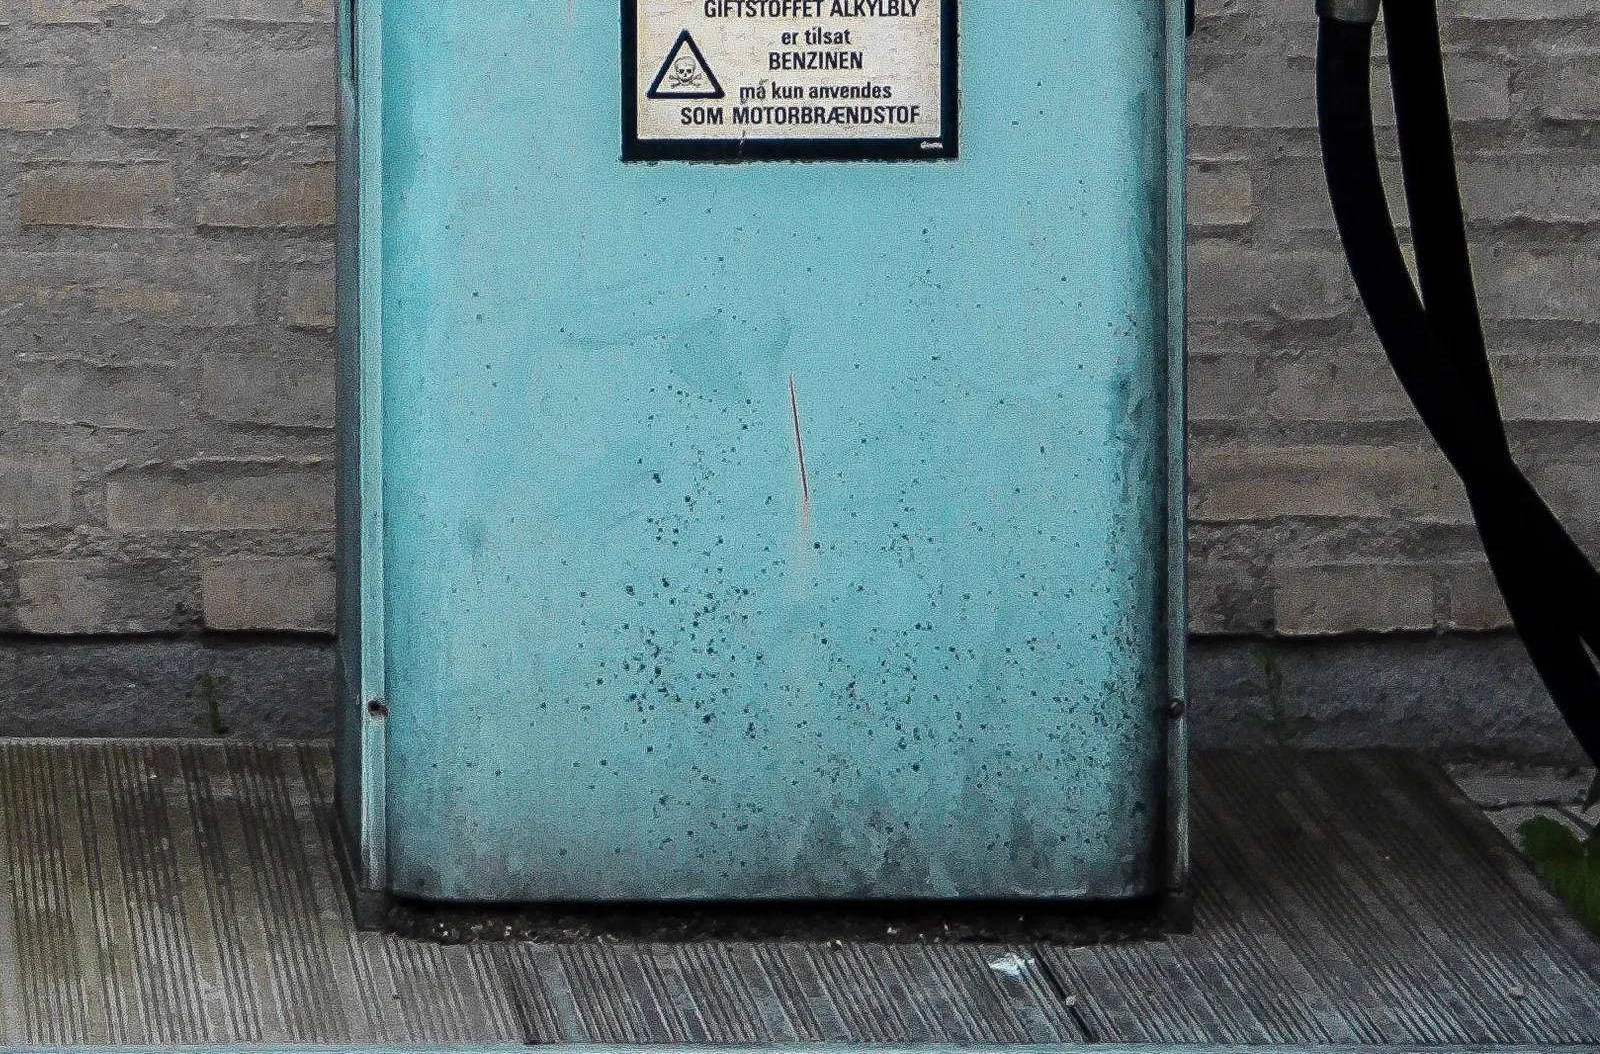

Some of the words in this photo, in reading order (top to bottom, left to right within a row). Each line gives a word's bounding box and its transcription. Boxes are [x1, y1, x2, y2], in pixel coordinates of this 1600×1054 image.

[781, 32, 799, 46] er
[804, 27, 851, 45] tilsat
[769, 51, 863, 71] BENZINEN
[739, 80, 766, 100] må
[771, 81, 804, 100] kun
[808, 81, 892, 100] anvendes
[680, 106, 724, 126] SOM
[732, 105, 920, 125] MOTORBRÆNDSTOF
